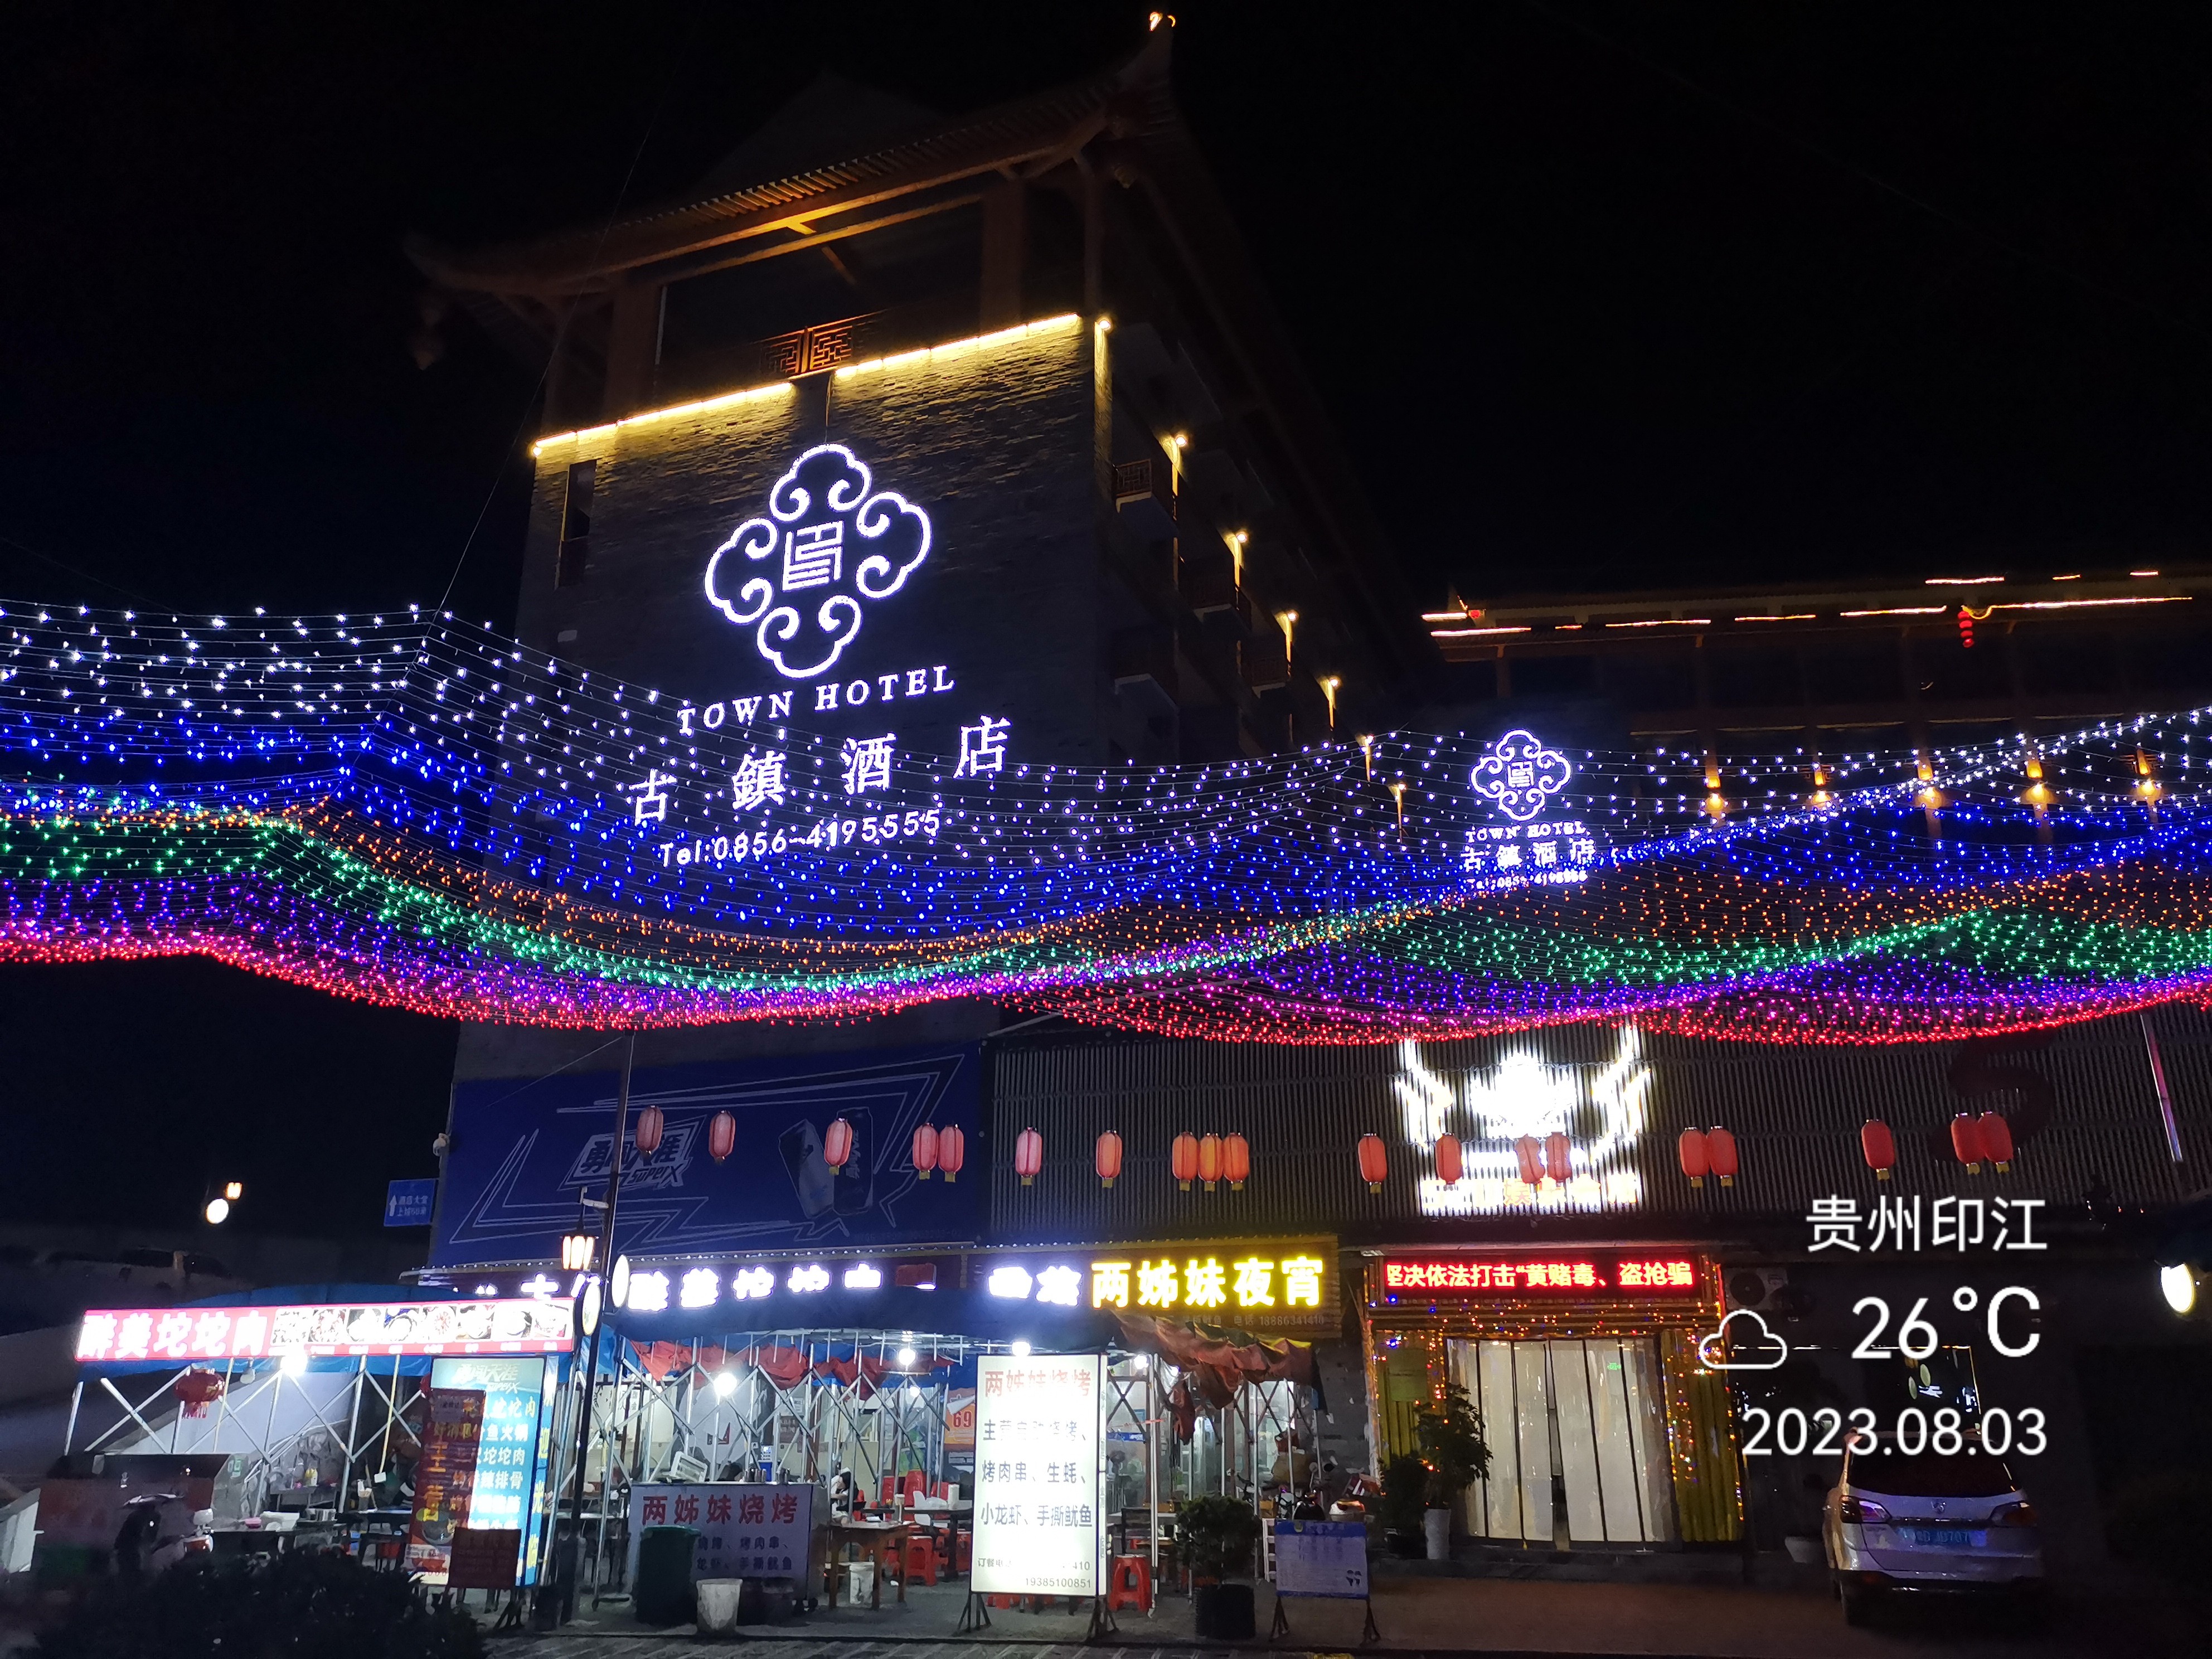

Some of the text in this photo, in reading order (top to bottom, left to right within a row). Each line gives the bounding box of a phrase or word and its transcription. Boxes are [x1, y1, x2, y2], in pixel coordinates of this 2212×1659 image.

[677, 665, 955, 736] TOWN HOTEL
[628, 715, 1011, 826] 古鎮酒店
[1465, 821, 1587, 843] TOWN HOTEL
[1090, 1255, 1323, 1309] 两姊妹夜宵
[1619, 1261, 1693, 1287] 盗抢骗
[481, 1423, 529, 1442] 鱼火锅
[475, 1470, 523, 1490] 辣排骨
[642, 1493, 798, 1525] 两姊妹烧烤
[1026, 1577, 1091, 1589] 19385100851
